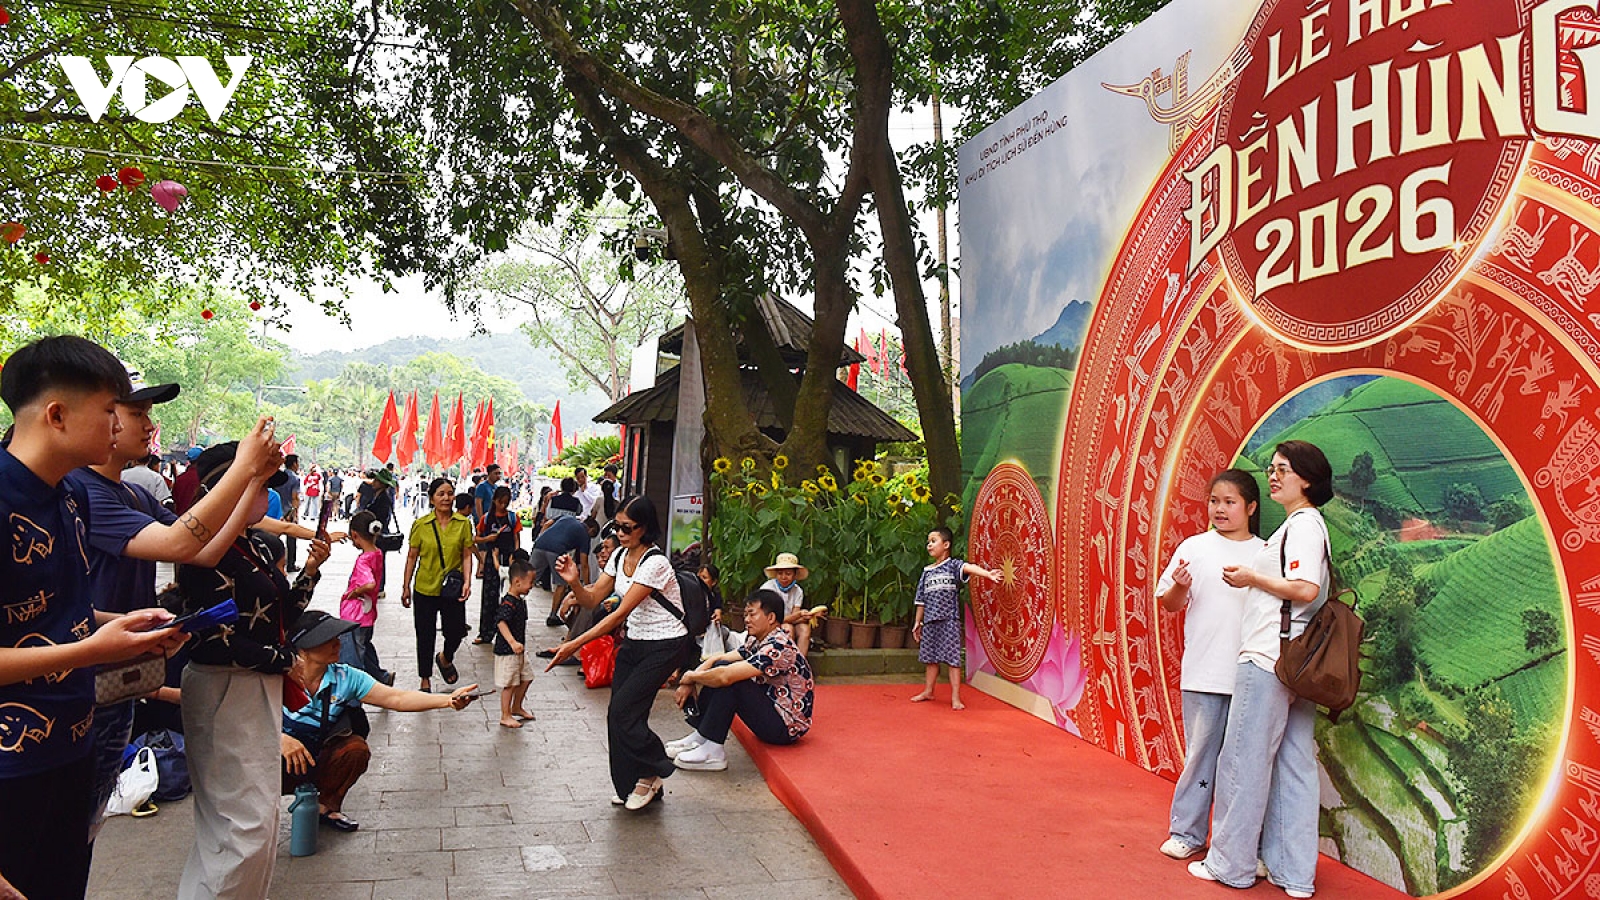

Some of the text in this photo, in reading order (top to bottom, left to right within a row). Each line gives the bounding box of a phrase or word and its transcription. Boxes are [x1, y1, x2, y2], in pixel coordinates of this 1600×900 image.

[964, 171, 978, 187] KHU
[1044, 115, 1068, 137] HÙNG
[979, 142, 999, 161] UBND
[1182, 95, 1322, 278] ĐỀN
[1254, 158, 1456, 302] 2026
